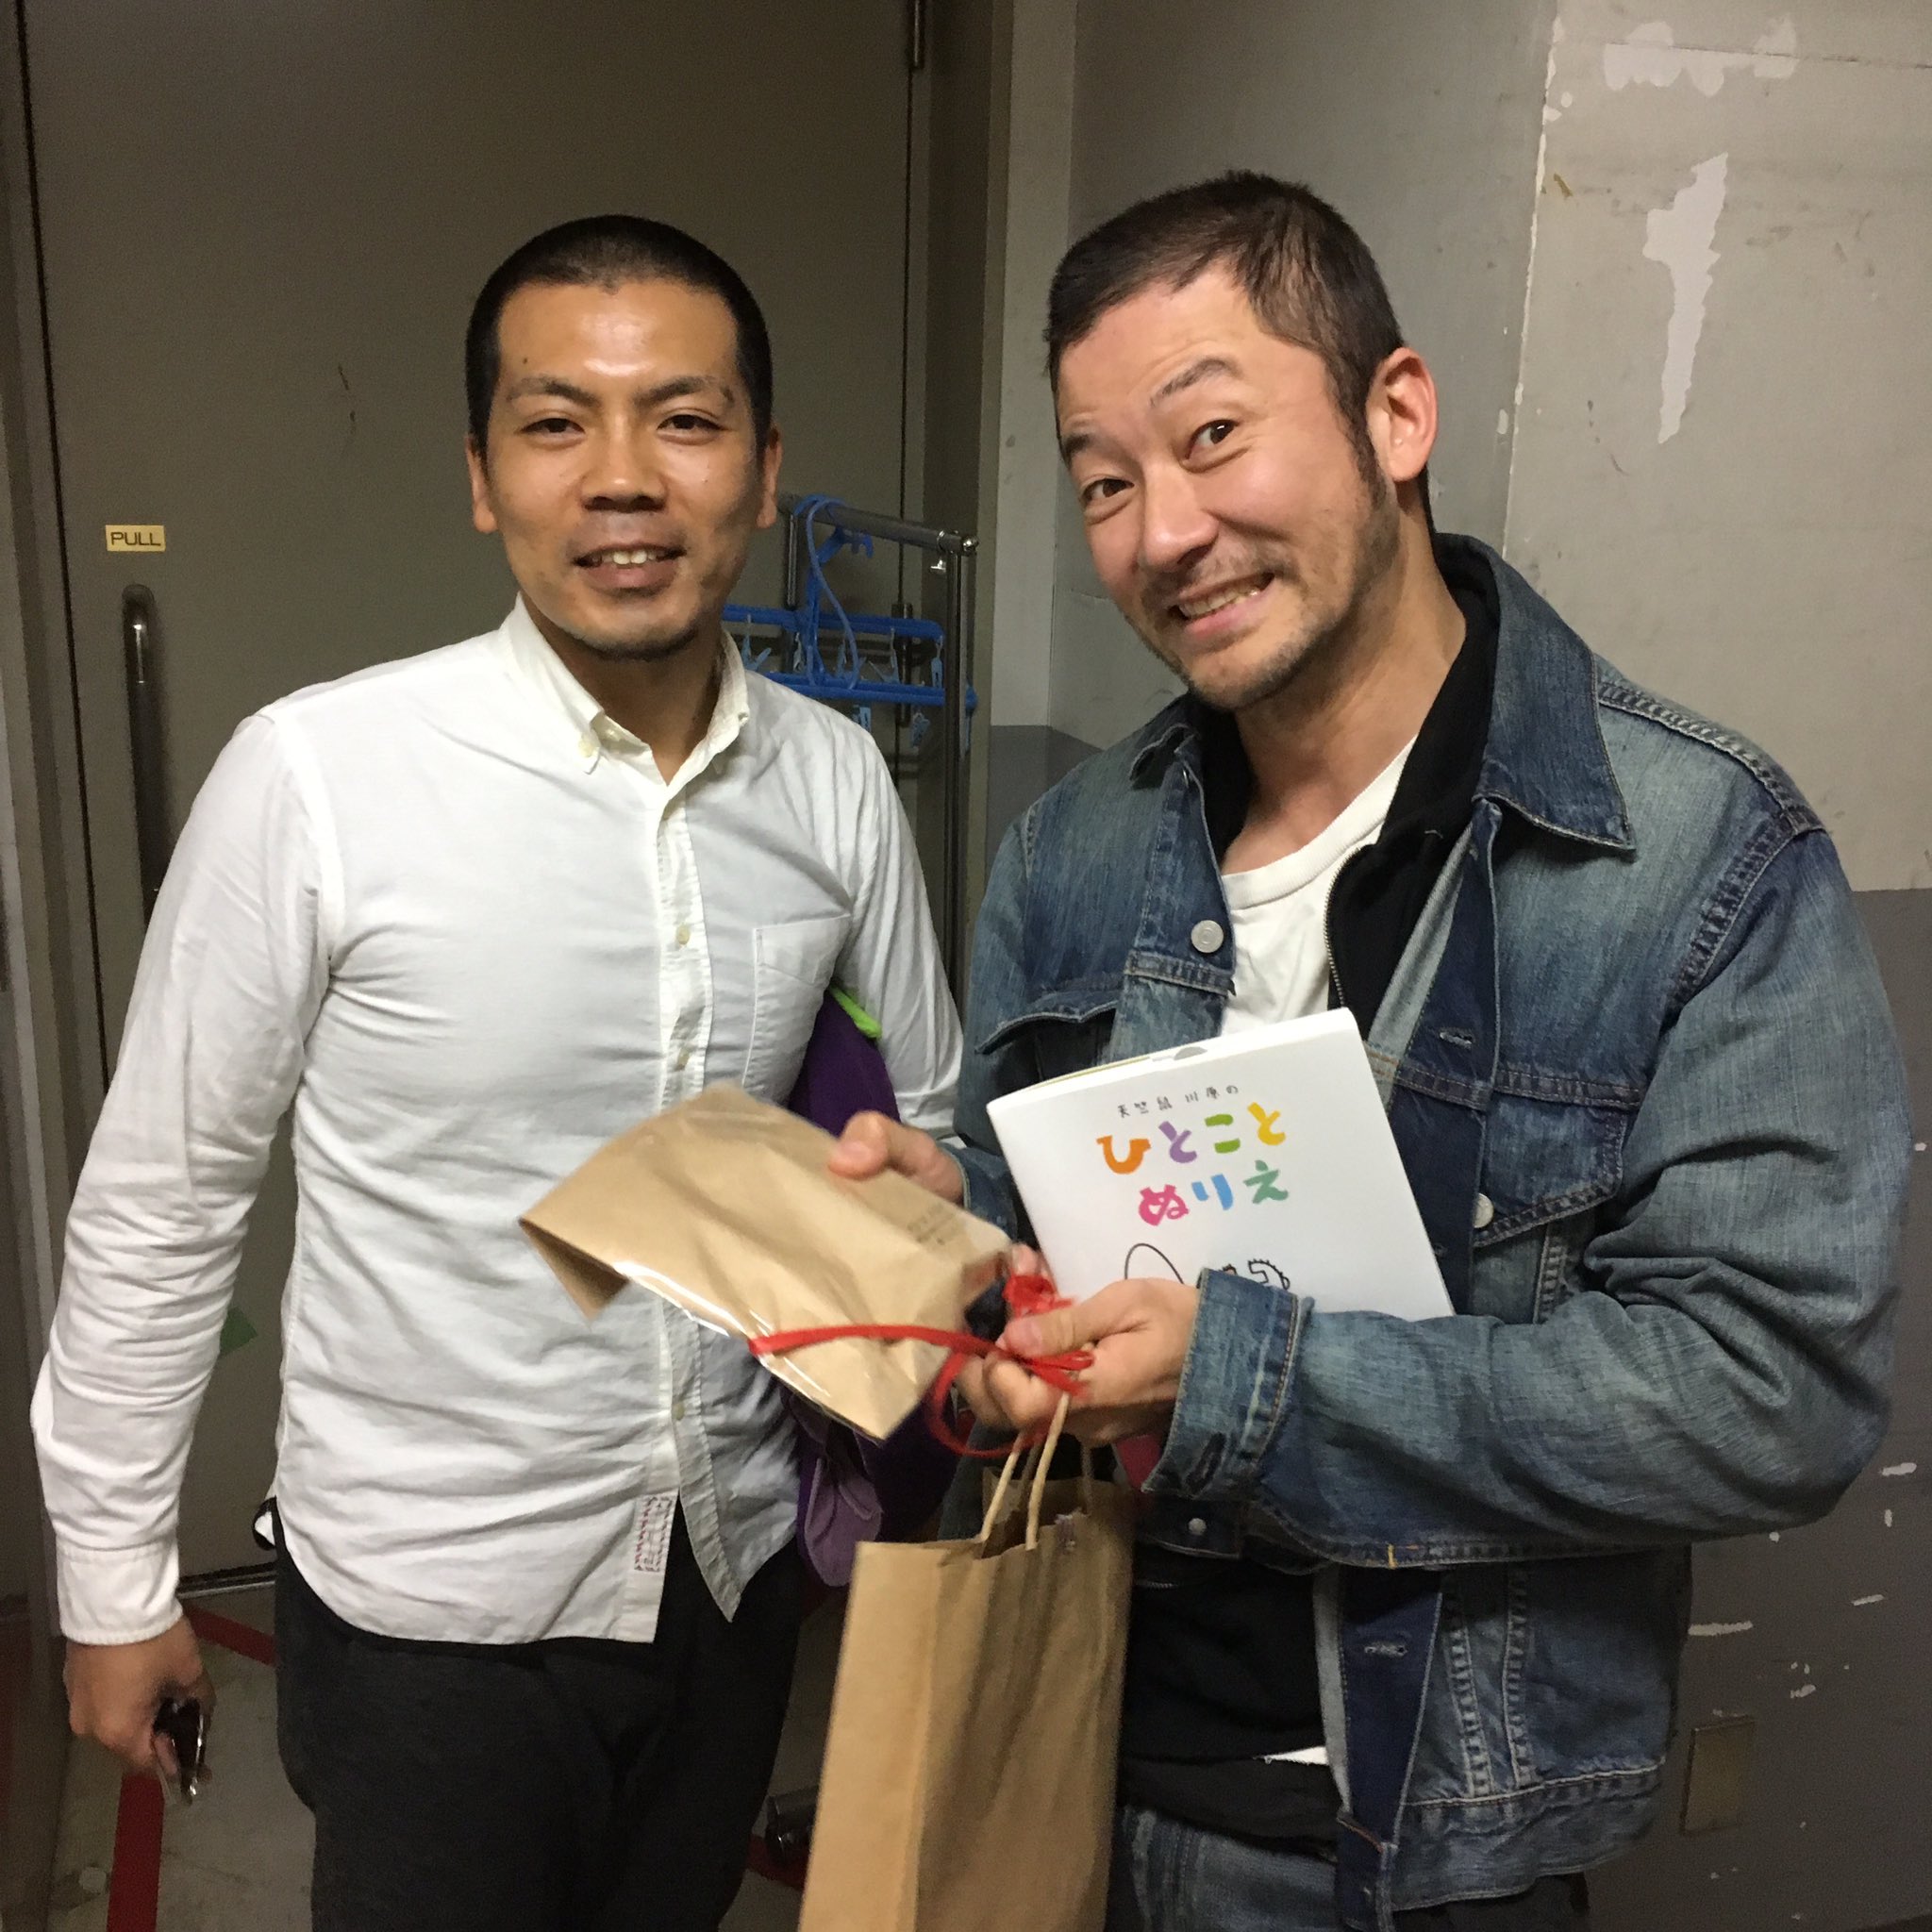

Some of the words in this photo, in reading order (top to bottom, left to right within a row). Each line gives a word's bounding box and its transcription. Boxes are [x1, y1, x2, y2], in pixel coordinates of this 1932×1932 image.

[110, 531, 161, 546] PULL
[1096, 1102, 1286, 1174] ひとこと
[1139, 1159, 1289, 1226] ぬりえ
